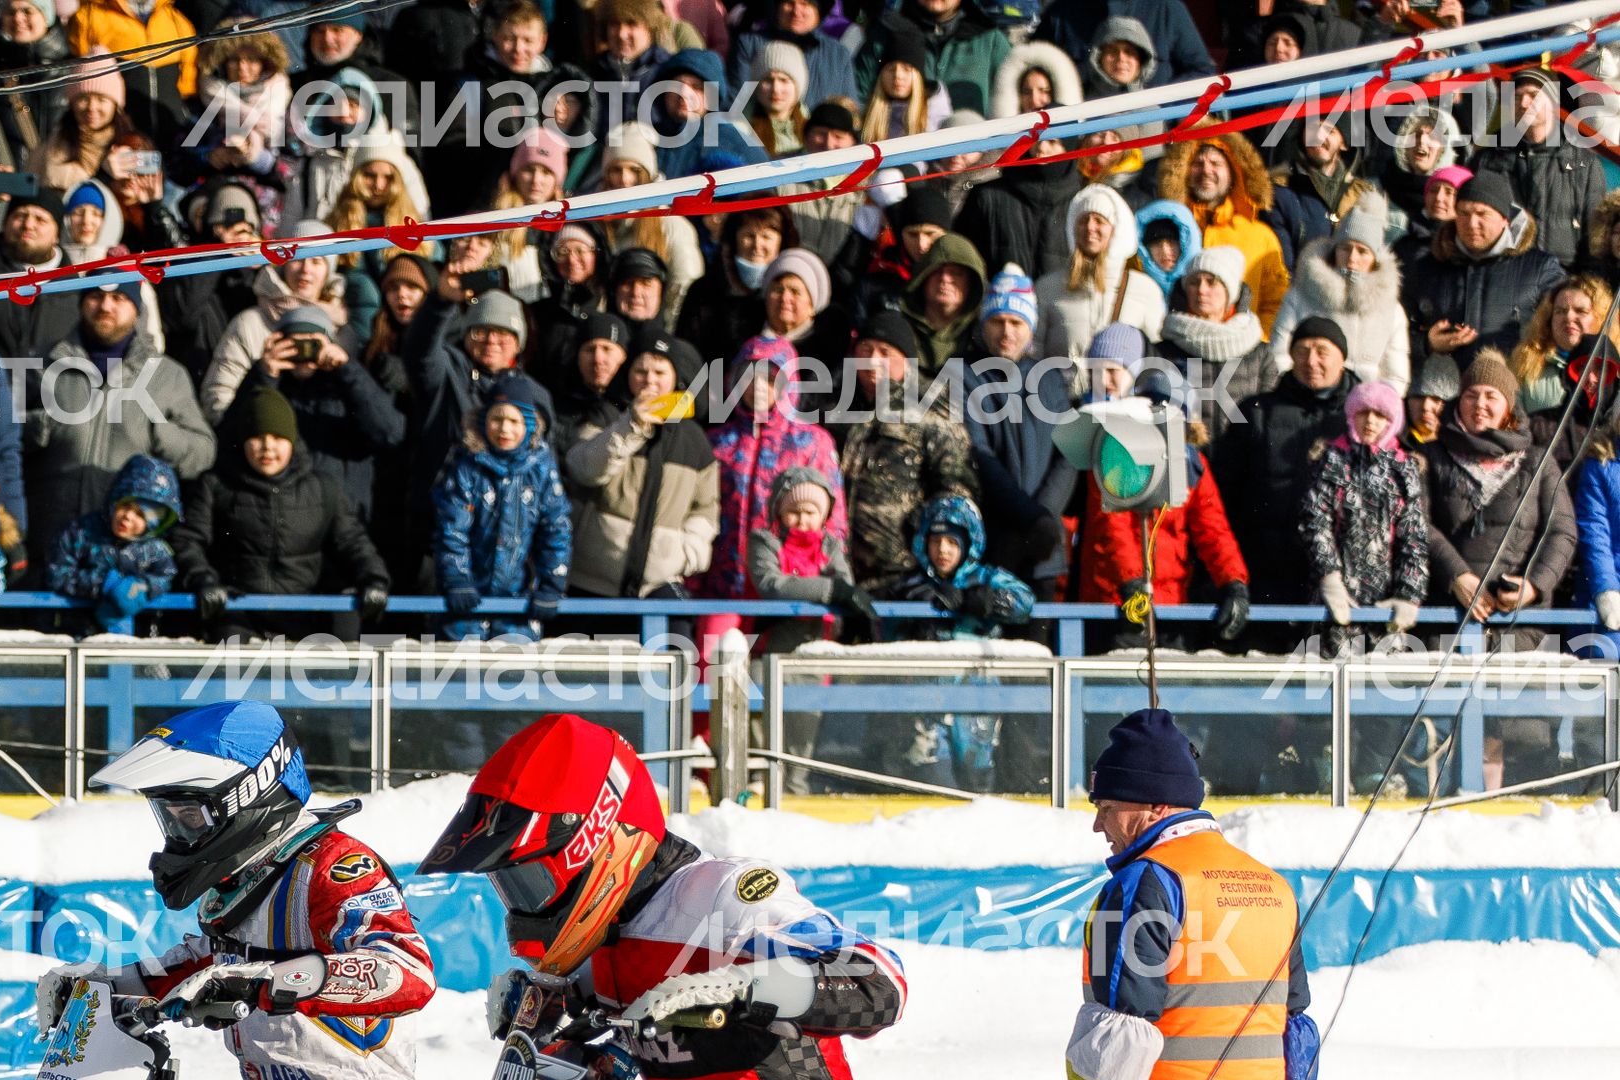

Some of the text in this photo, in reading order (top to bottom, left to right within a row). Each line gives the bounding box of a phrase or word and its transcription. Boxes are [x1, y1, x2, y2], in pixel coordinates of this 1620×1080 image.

[222, 737, 291, 817] 100%
[567, 786, 619, 863] EKS
[1202, 870, 1274, 881] МОТОФЕДЕРАЦИЯ
[1216, 897, 1283, 908] БАШКОРТОСТАН
